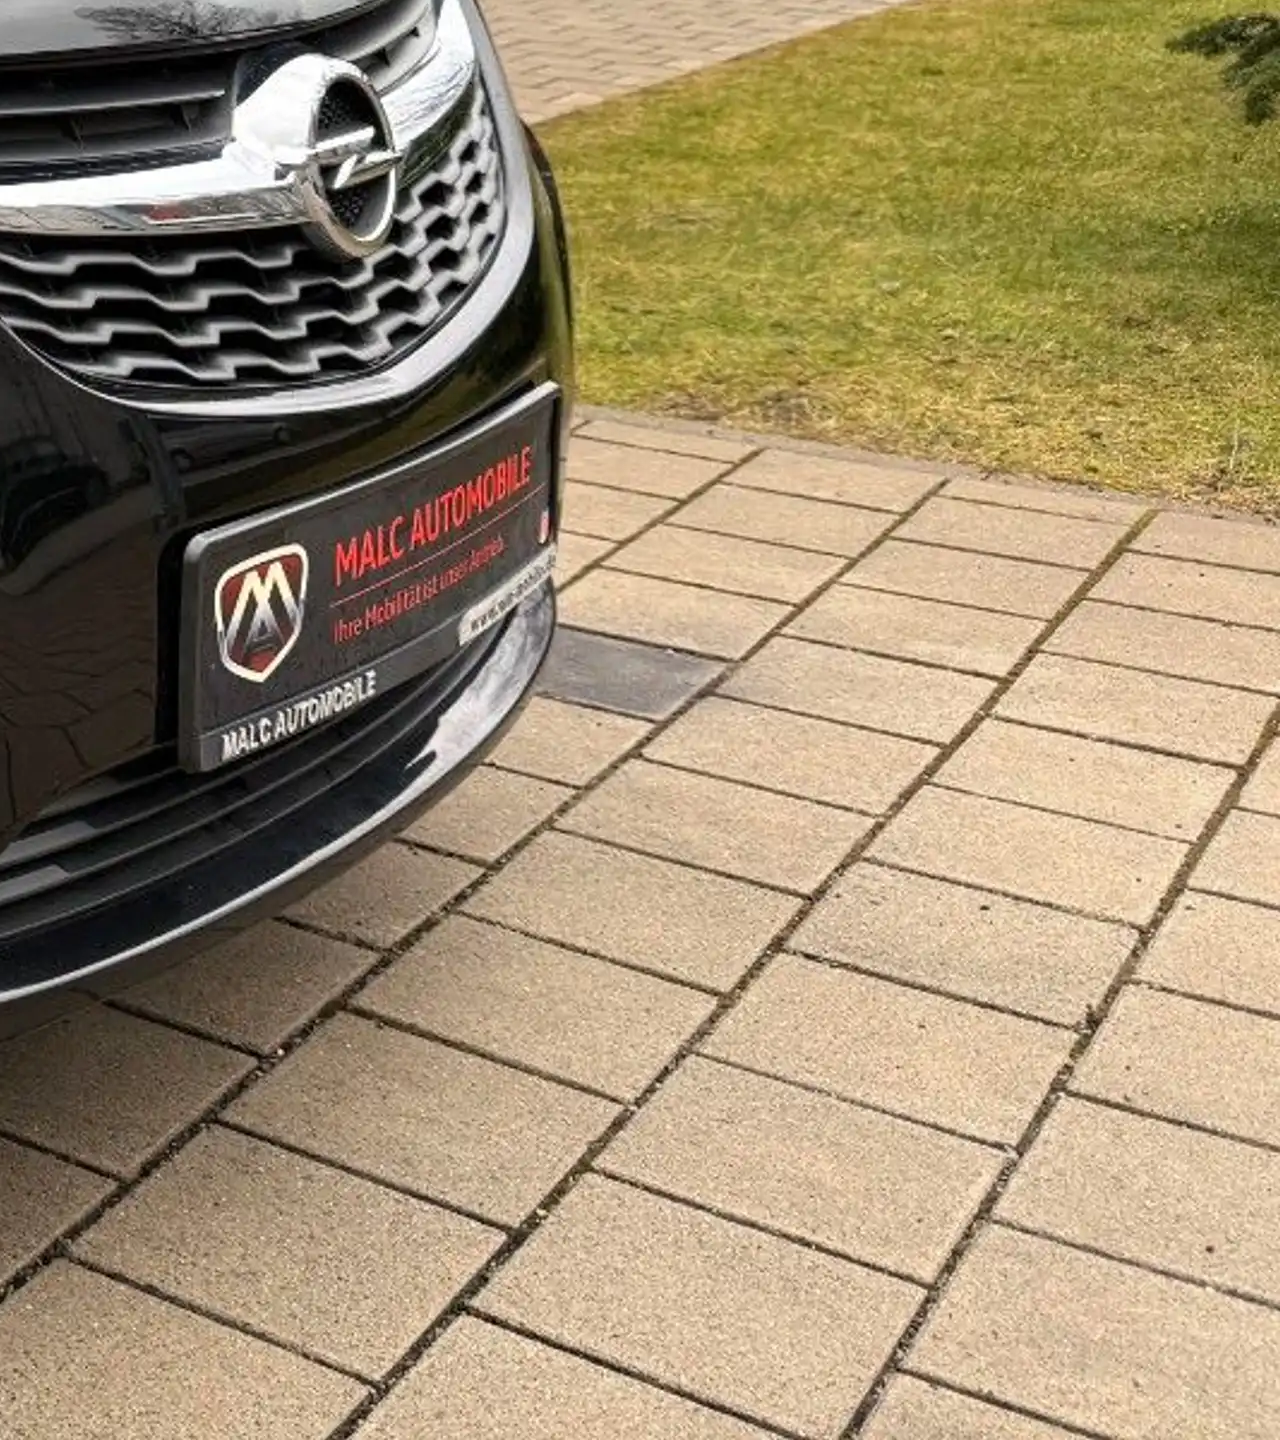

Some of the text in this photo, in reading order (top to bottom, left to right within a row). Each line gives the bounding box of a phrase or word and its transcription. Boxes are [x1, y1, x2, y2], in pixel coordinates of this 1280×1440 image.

[333, 515, 407, 587] MALC
[409, 446, 533, 551] AUTOMOBILE
[332, 617, 362, 645] Ihre
[221, 669, 378, 762] MALC AUTOMOBILE
